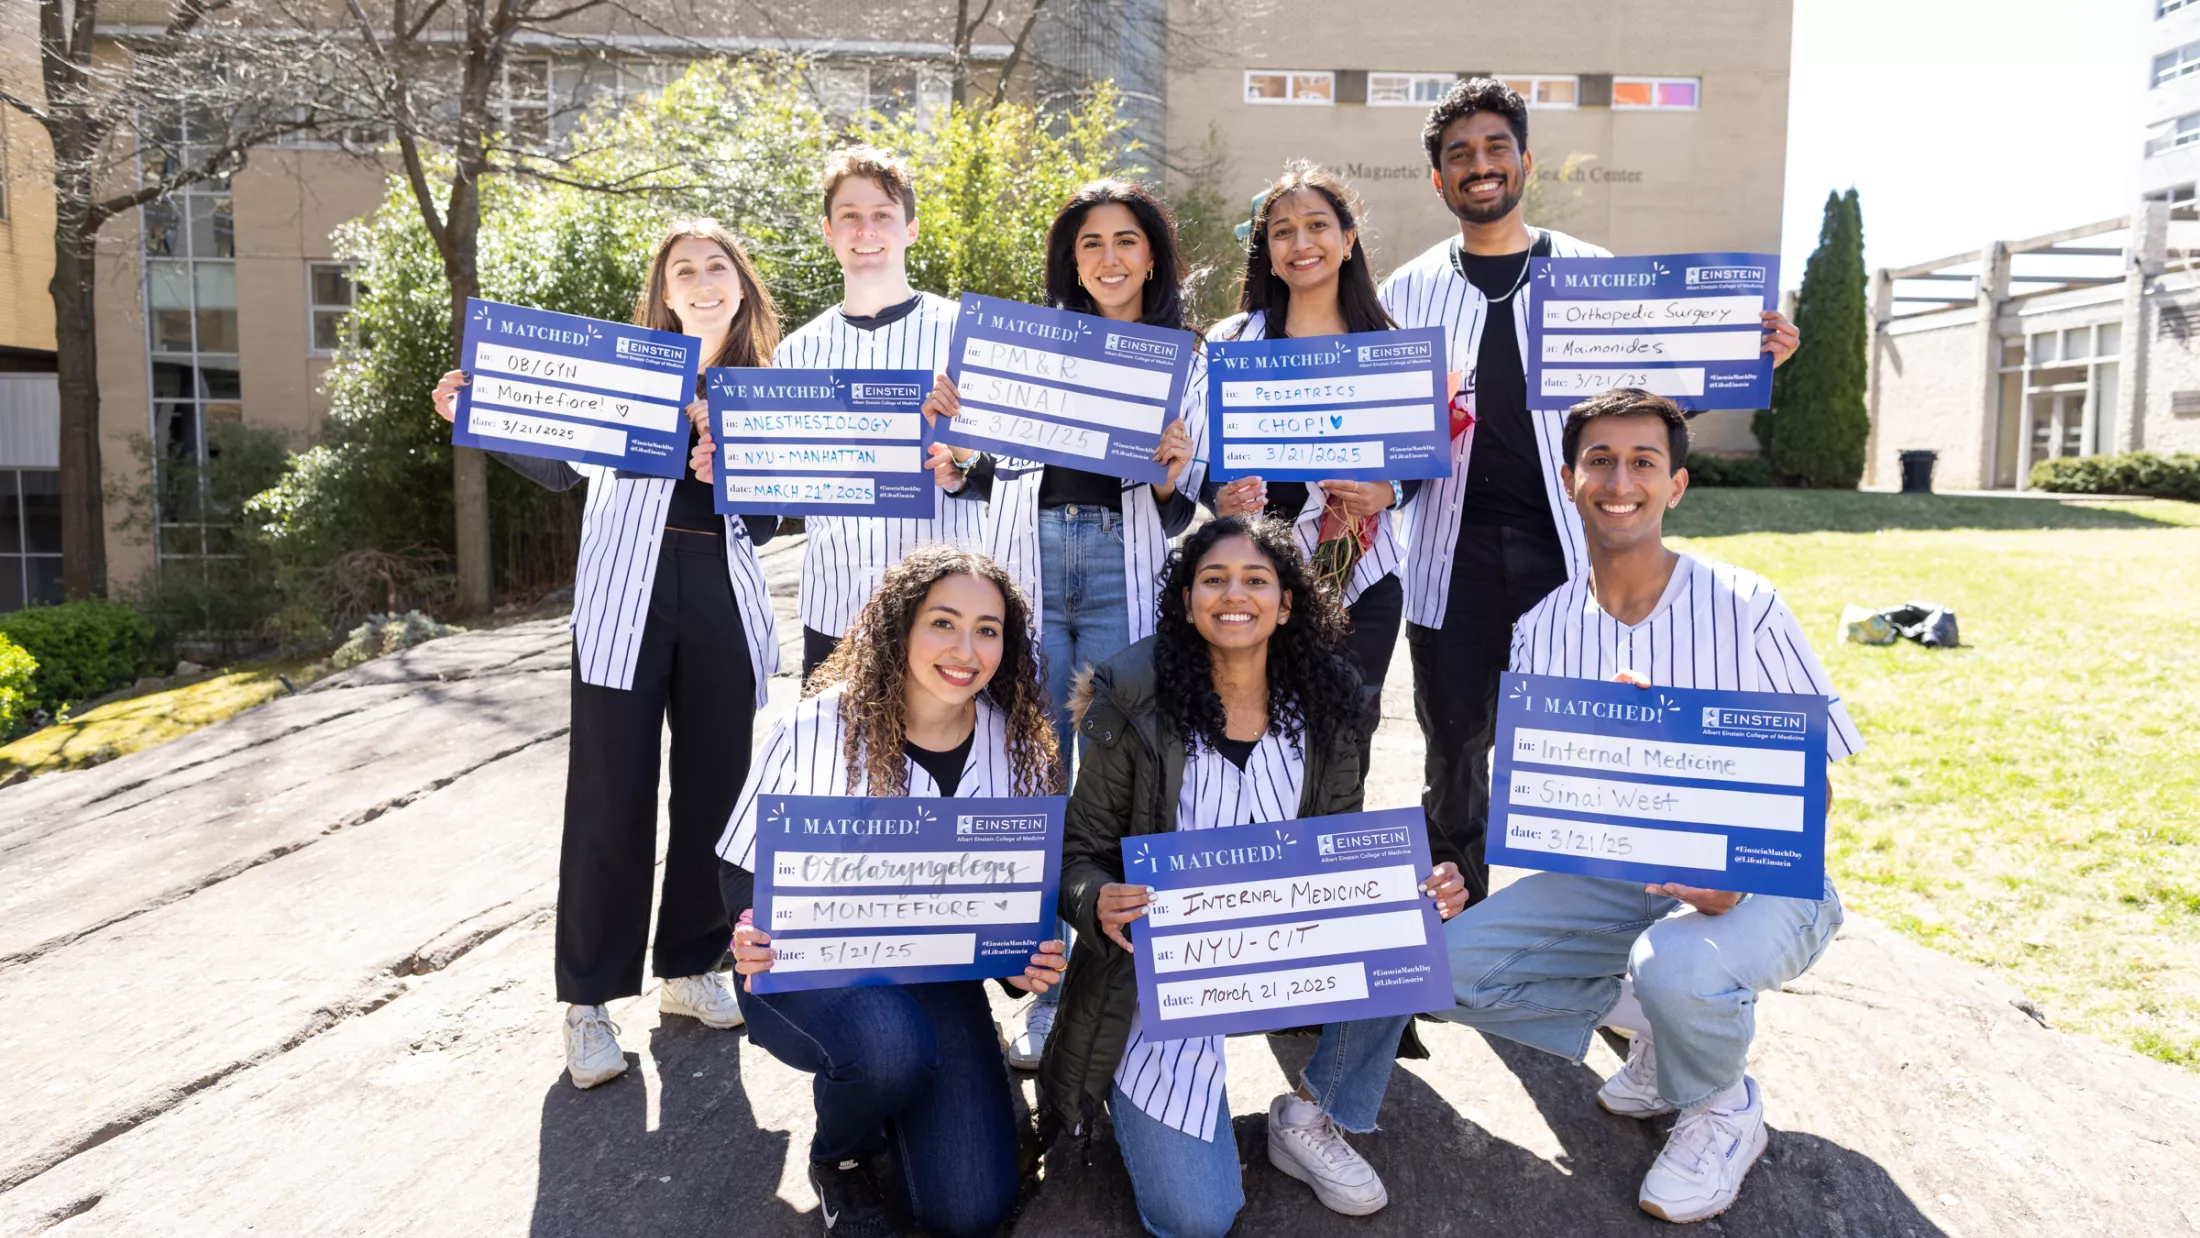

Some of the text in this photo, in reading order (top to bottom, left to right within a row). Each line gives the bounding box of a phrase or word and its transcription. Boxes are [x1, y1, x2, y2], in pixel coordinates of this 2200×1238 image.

[1346, 163, 1421, 181] Magnetic
[1590, 166, 1644, 183] Center
[1551, 273, 1656, 287] I MATCHED!
[1701, 269, 1762, 280] EINSTEIN
[1566, 304, 1653, 326] Orthopedic
[1665, 302, 1732, 325] Surgery
[486, 318, 589, 347] I MATCHED!
[977, 313, 1078, 343] I MATCHED!
[630, 343, 682, 359] EINSTEIN
[968, 346, 980, 357] in:
[1120, 339, 1173, 355] EINSTEIN
[1373, 345, 1427, 357] EINSTEIN
[1563, 338, 1663, 356] Maimonides
[480, 353, 577, 378] in: OB/GYN
[1224, 351, 1340, 369] WE MATCHED!
[1544, 373, 1647, 389] date: 3/21/25
[476, 384, 604, 412] at: Montefiore!
[722, 385, 835, 398] WE MATCHED!
[865, 387, 916, 396] EINSTEIN
[988, 380, 1067, 412] SINAI
[1226, 385, 1355, 401] in: PEDIATRICS
[472, 417, 574, 440] date: 3/21/2025
[726, 415, 892, 432] in: ANESTHESIOLOGY
[954, 414, 1092, 449] date: 3/21/25
[1258, 416, 1324, 435] CHOP!
[1227, 443, 1361, 464] date: 3/21/2025
[729, 484, 751, 493] date:
[754, 484, 798, 498] MARCH
[837, 486, 873, 499] 2025
[1526, 697, 1662, 723] I MATCHED!
[1723, 713, 1800, 728] EINSTEIN
[1746, 732, 1769, 740] College
[1519, 738, 1735, 775] in: Internal Medicine
[1514, 779, 1679, 811] at: Sinai West
[784, 818, 920, 835] I MATCHED!
[976, 819, 1042, 830] EINSTEIN
[1337, 832, 1404, 849] EINSTEIN
[1511, 825, 1632, 855] date: 3/21/25
[1151, 844, 1282, 873] I MATCHED!
[779, 862, 795, 874] in:
[776, 900, 985, 921] at: MONTEFIORE
[1152, 903, 1169, 915] in:
[775, 950, 805, 961] date:
[1158, 951, 1173, 960] at:
[1163, 994, 1193, 1007] date:
[1201, 983, 1253, 1006] March
